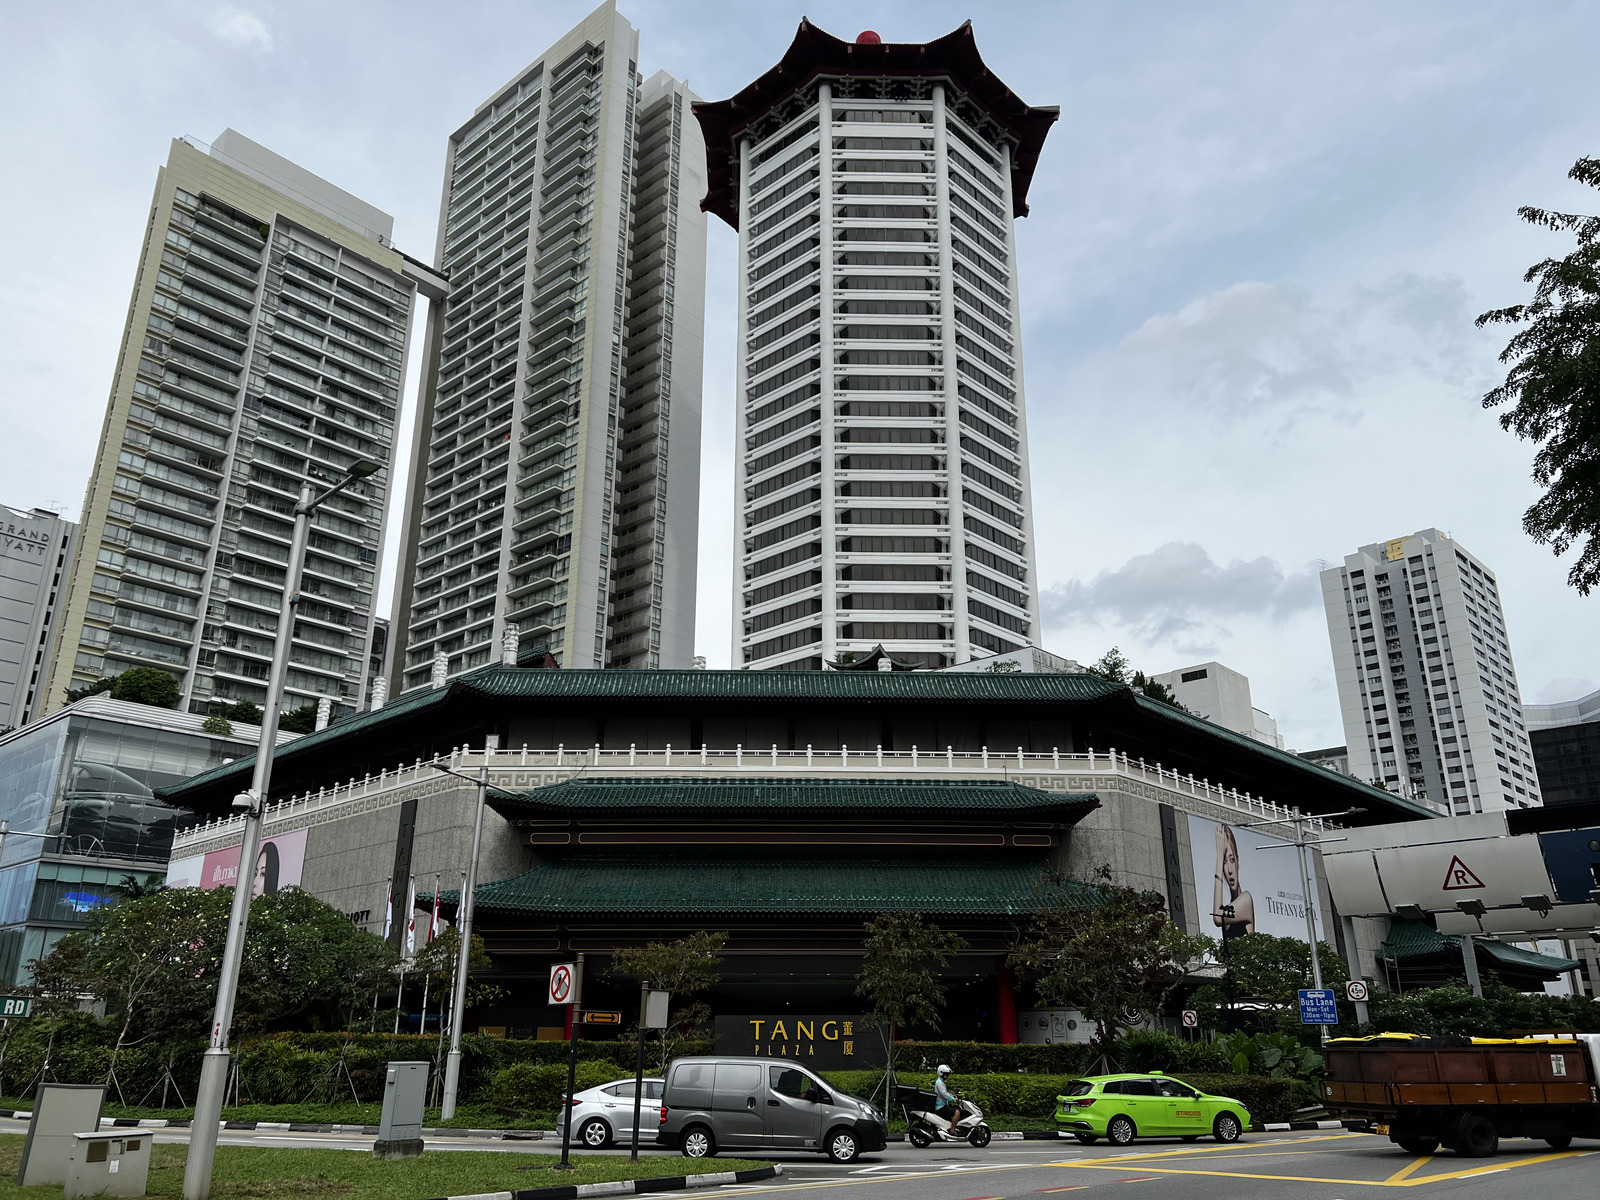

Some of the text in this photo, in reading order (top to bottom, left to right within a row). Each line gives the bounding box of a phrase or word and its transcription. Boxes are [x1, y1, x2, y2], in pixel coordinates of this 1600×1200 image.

[0, 536, 46, 556] YATT
[1453, 869, 1470, 885] R
[4, 999, 25, 1015] RD
[1300, 997, 1334, 1006] Bus Lane
[749, 1020, 839, 1041] TANG
[754, 1044, 814, 1056] PLAZA
